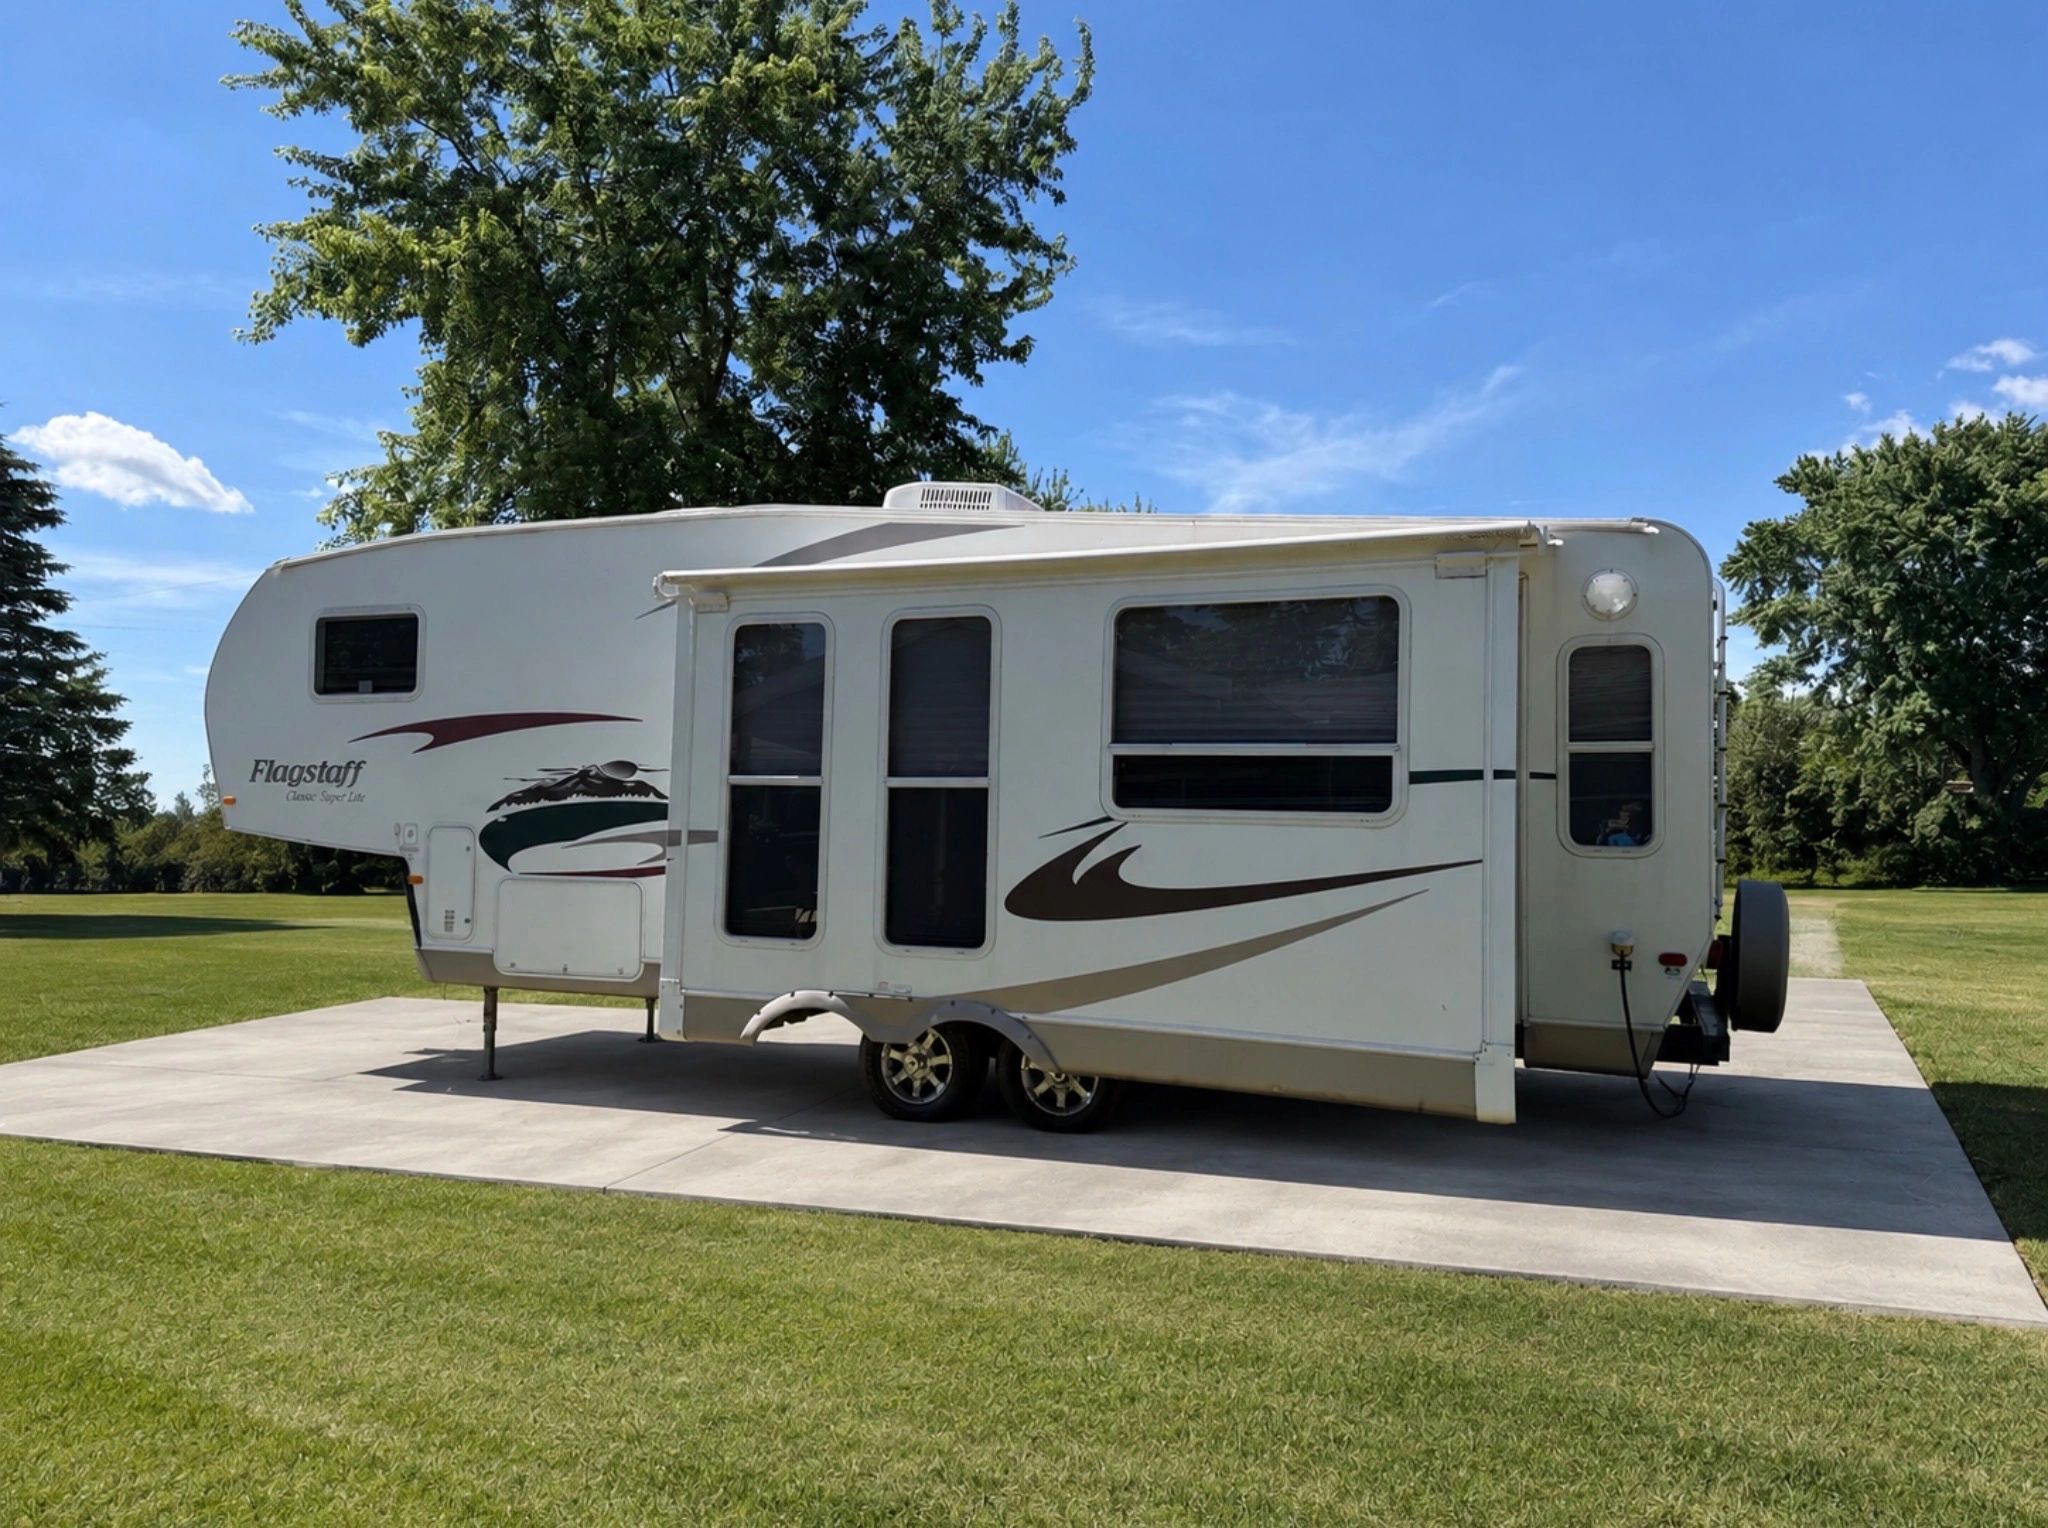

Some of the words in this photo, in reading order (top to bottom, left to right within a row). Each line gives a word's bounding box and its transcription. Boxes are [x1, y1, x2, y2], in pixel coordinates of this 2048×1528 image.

[249, 759, 367, 788] Flagstaff
[286, 790, 317, 802] Classic
[320, 790, 346, 805] Super
[347, 791, 366, 803] Lite
